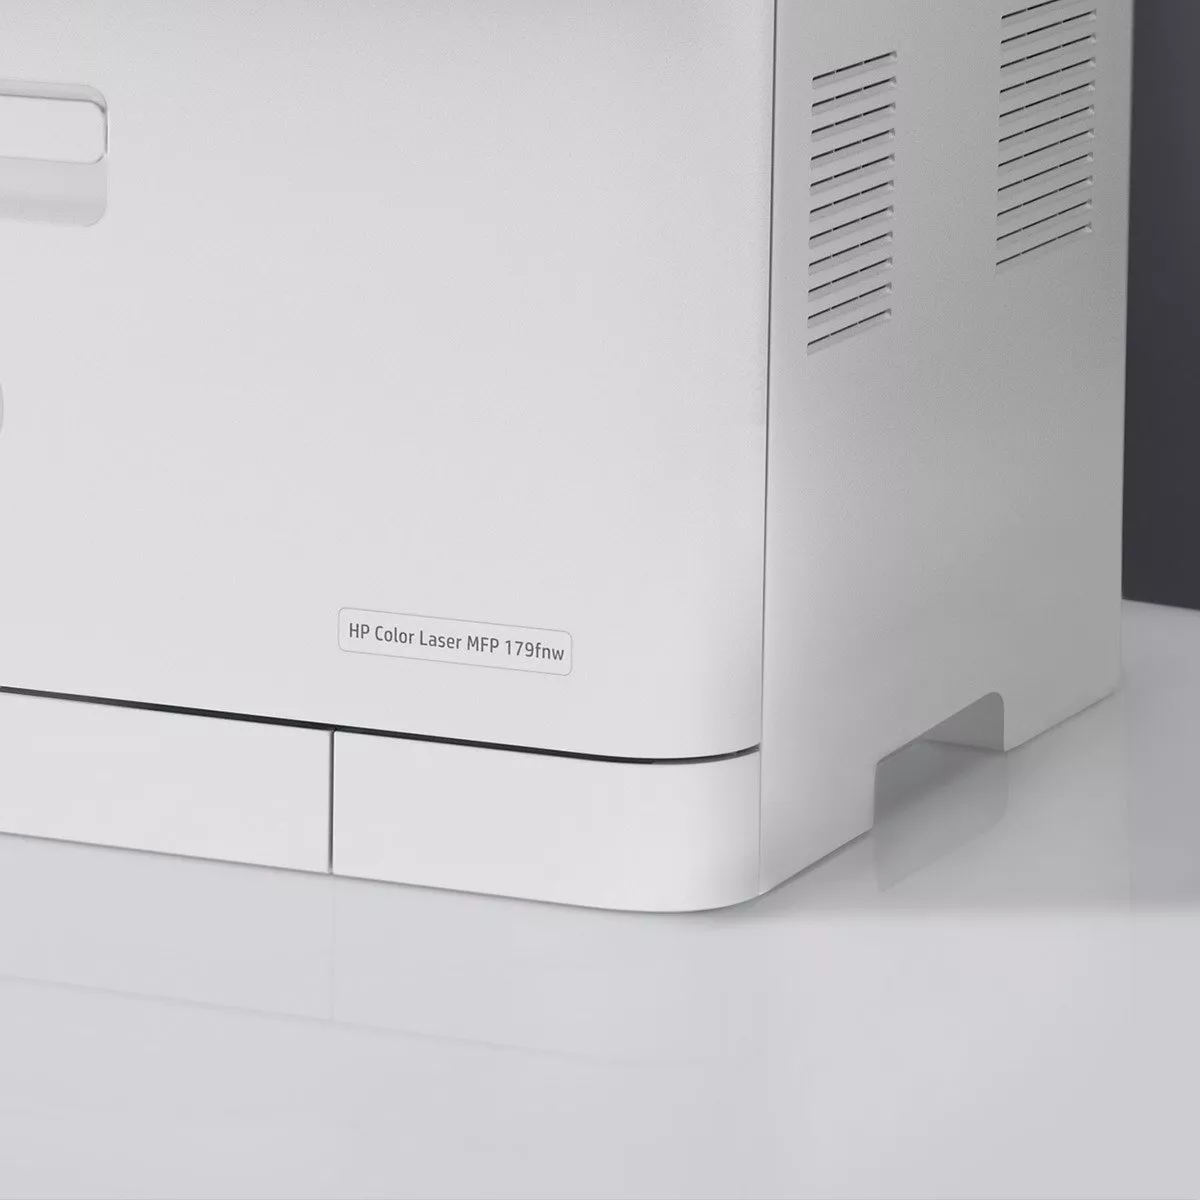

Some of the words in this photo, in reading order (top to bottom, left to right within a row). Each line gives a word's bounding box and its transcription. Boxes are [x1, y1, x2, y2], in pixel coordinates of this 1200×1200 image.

[348, 622, 370, 639] HP
[374, 625, 414, 644] Color
[419, 630, 461, 650] Laser
[466, 635, 499, 653] MFP
[504, 639, 564, 661] 179fnw
